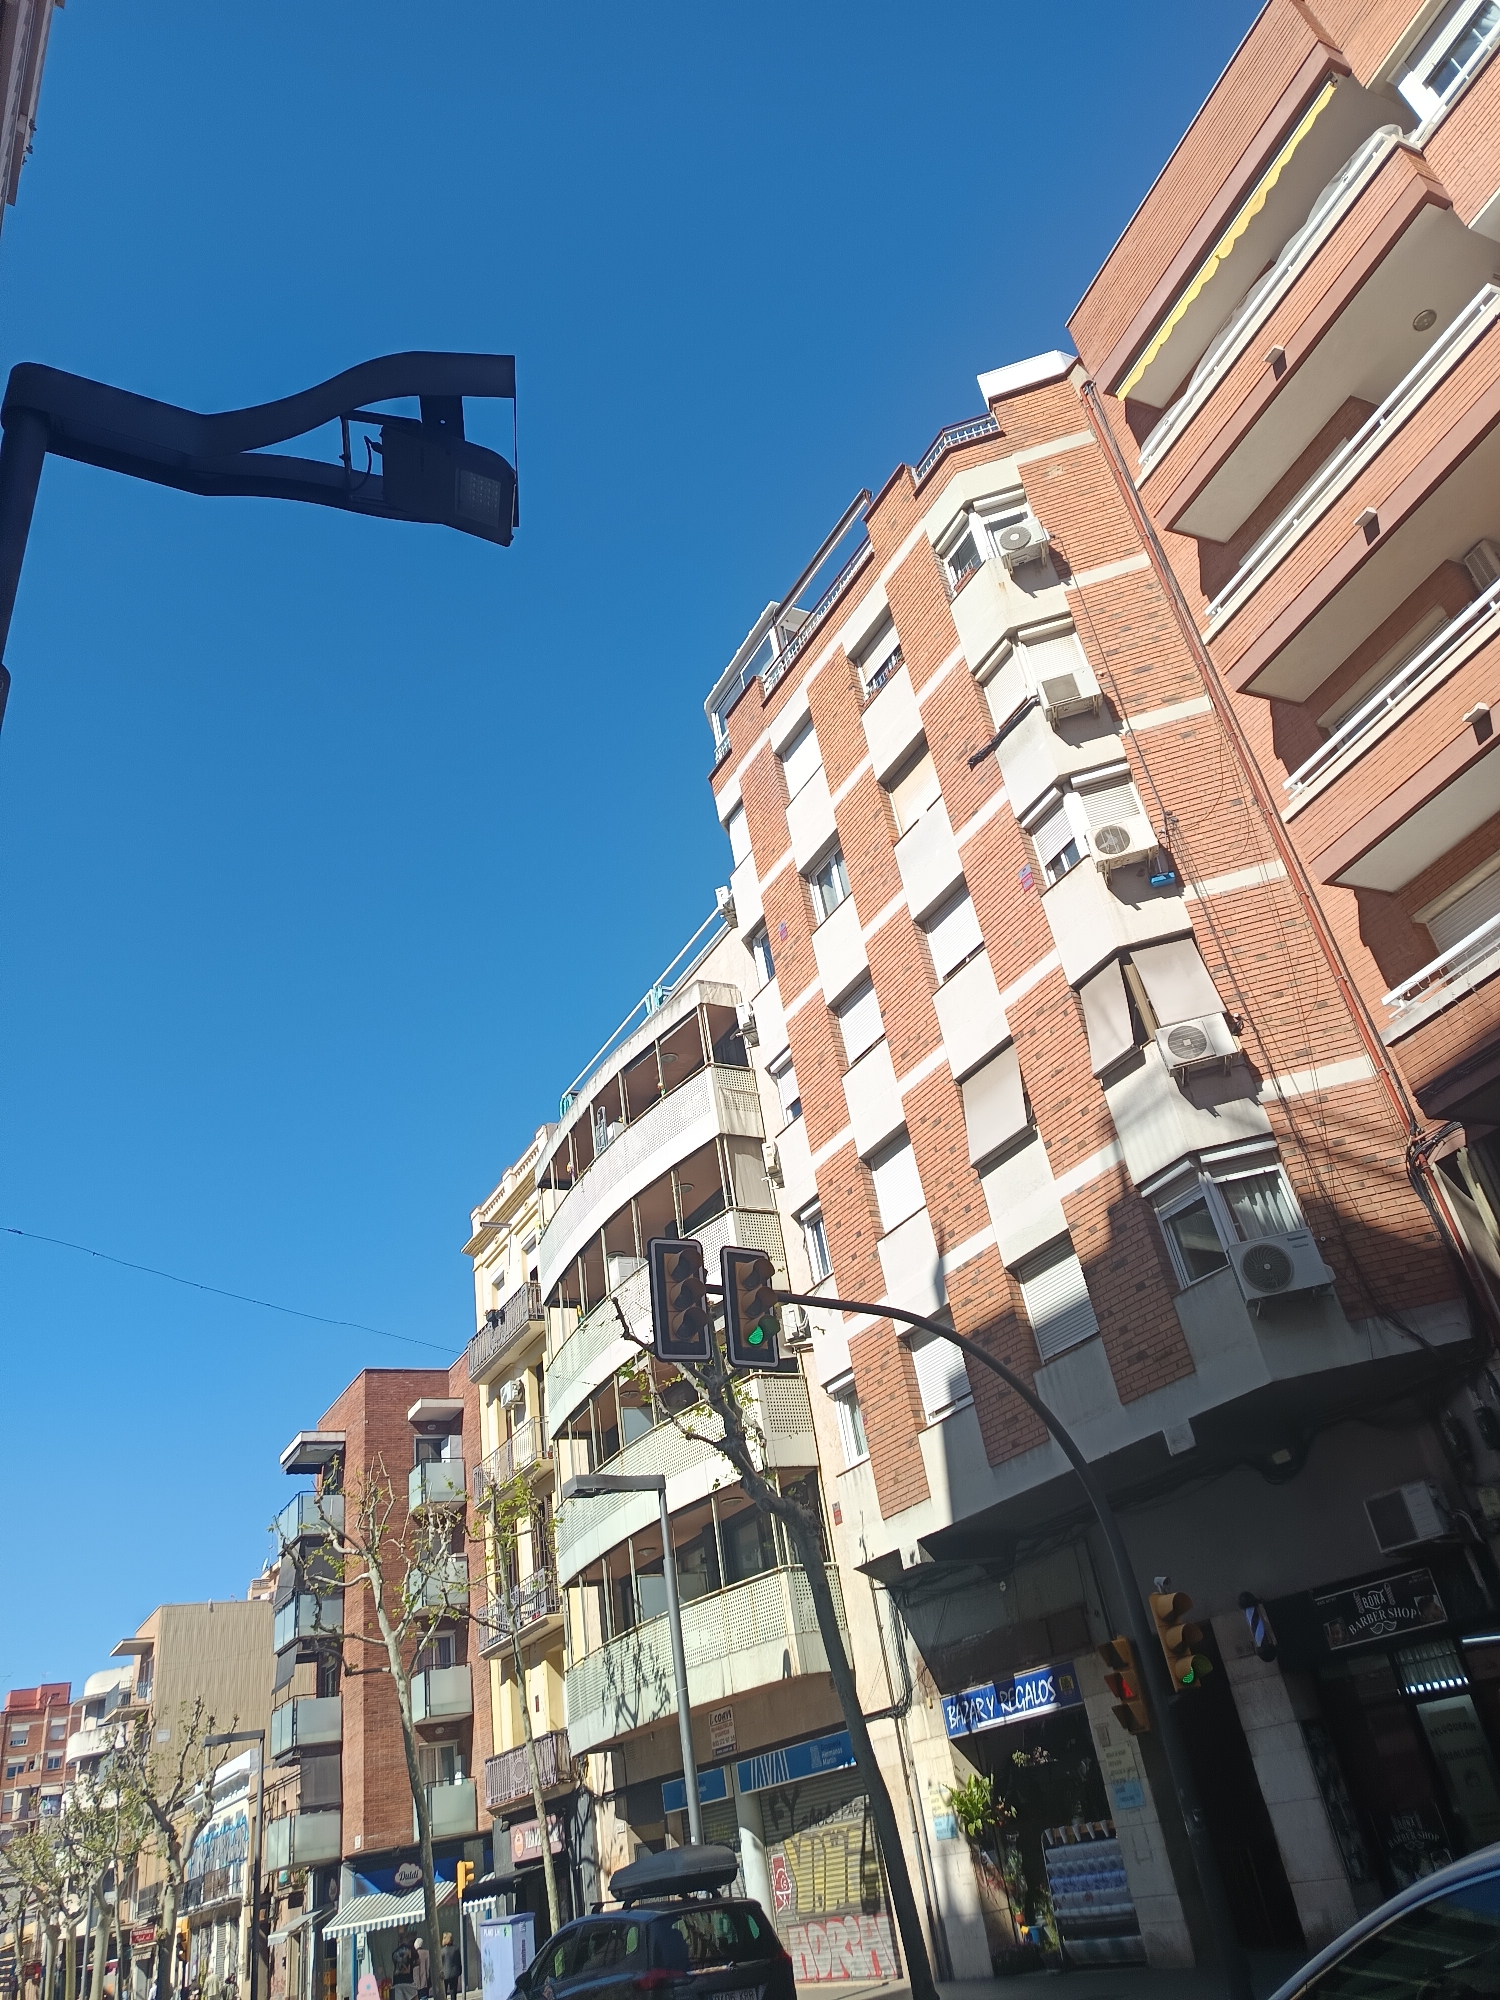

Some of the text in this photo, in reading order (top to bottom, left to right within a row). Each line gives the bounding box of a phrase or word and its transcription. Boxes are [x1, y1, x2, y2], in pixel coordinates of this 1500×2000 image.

[1361, 1593, 1387, 1609] BONA
[1348, 1607, 1417, 1635] BARBER SHOP
[946, 1675, 1056, 1729] BAZAR Y REGALOS
[1388, 1831, 1440, 1849] BARBER SHOP
